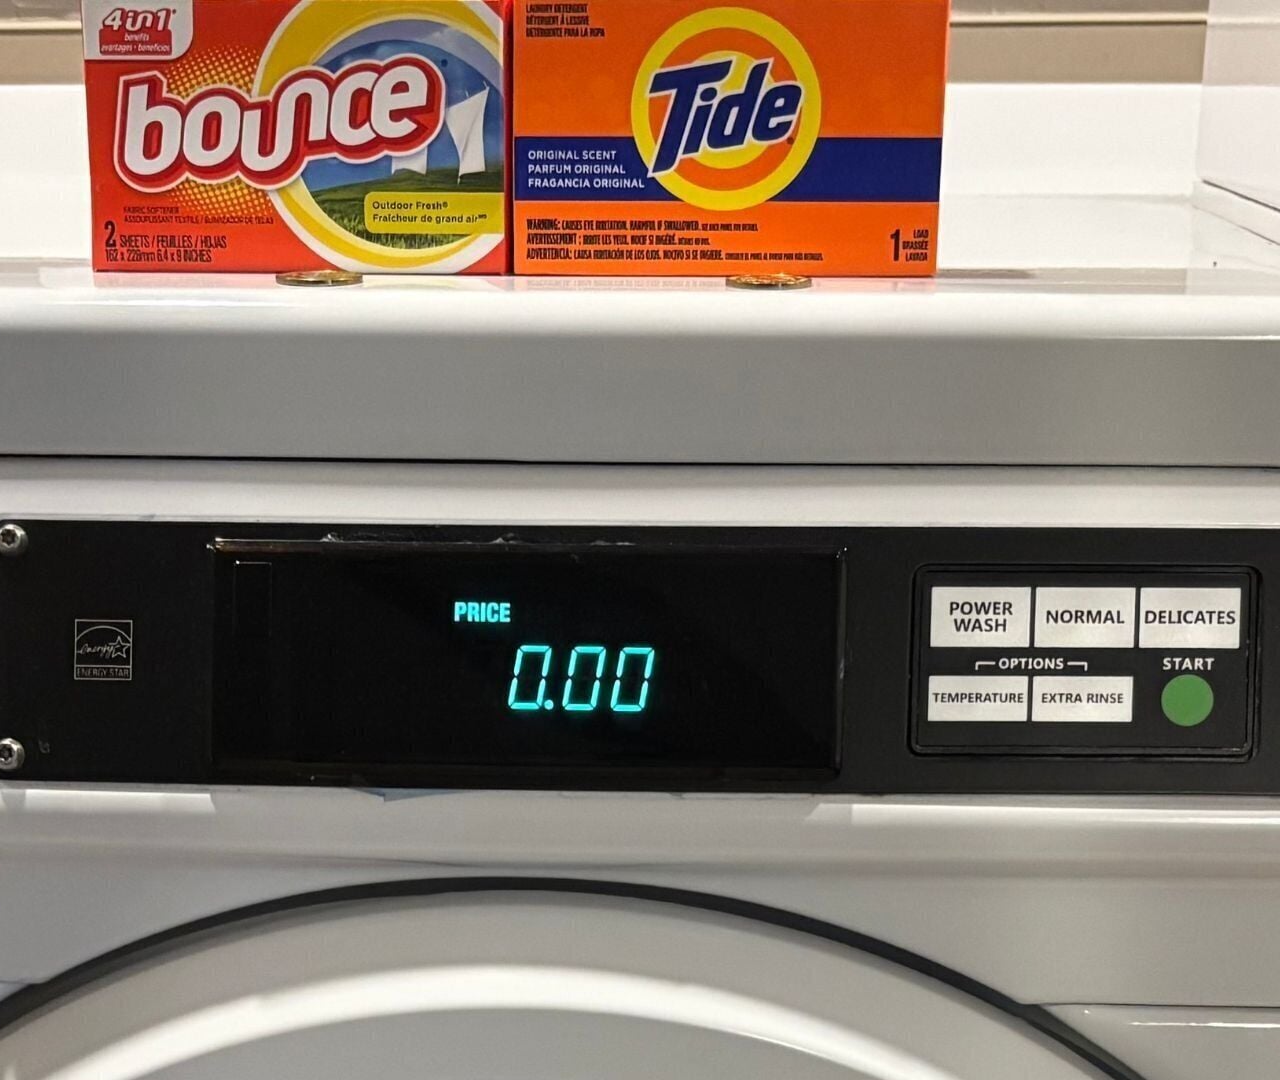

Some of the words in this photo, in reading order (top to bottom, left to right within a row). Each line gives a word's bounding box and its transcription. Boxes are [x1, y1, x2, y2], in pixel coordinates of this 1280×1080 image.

[121, 61, 431, 178] bounce
[648, 58, 803, 175] Tide
[528, 150, 580, 160] ORIGINAL
[582, 150, 617, 160] SCENT
[528, 164, 571, 174] PARFUM
[574, 164, 626, 174] ORIGINAL
[528, 178, 591, 188] FRAGANCIA
[593, 178, 645, 188] ORIGINAL
[372, 201, 413, 210] Outdoor
[420, 213, 430, 223] de
[435, 214, 464, 224] grand
[104, 220, 117, 248] 2
[120, 235, 150, 248] SHEETS
[890, 229, 900, 262] 1
[454, 601, 511, 623] PRICE
[949, 601, 1013, 616] POWER
[1045, 610, 1125, 625] NORMAL
[1144, 610, 1236, 626] DELICATES
[953, 618, 1008, 633] WASH
[998, 657, 1064, 671] OPTIONS
[1162, 657, 1215, 671] START
[109, 668, 129, 678] STAR
[508, 644, 655, 712] 0.00
[932, 692, 1024, 704] TEMPERATURE
[1041, 692, 1083, 704] EXTRA
[1086, 692, 1124, 704] RINSE
